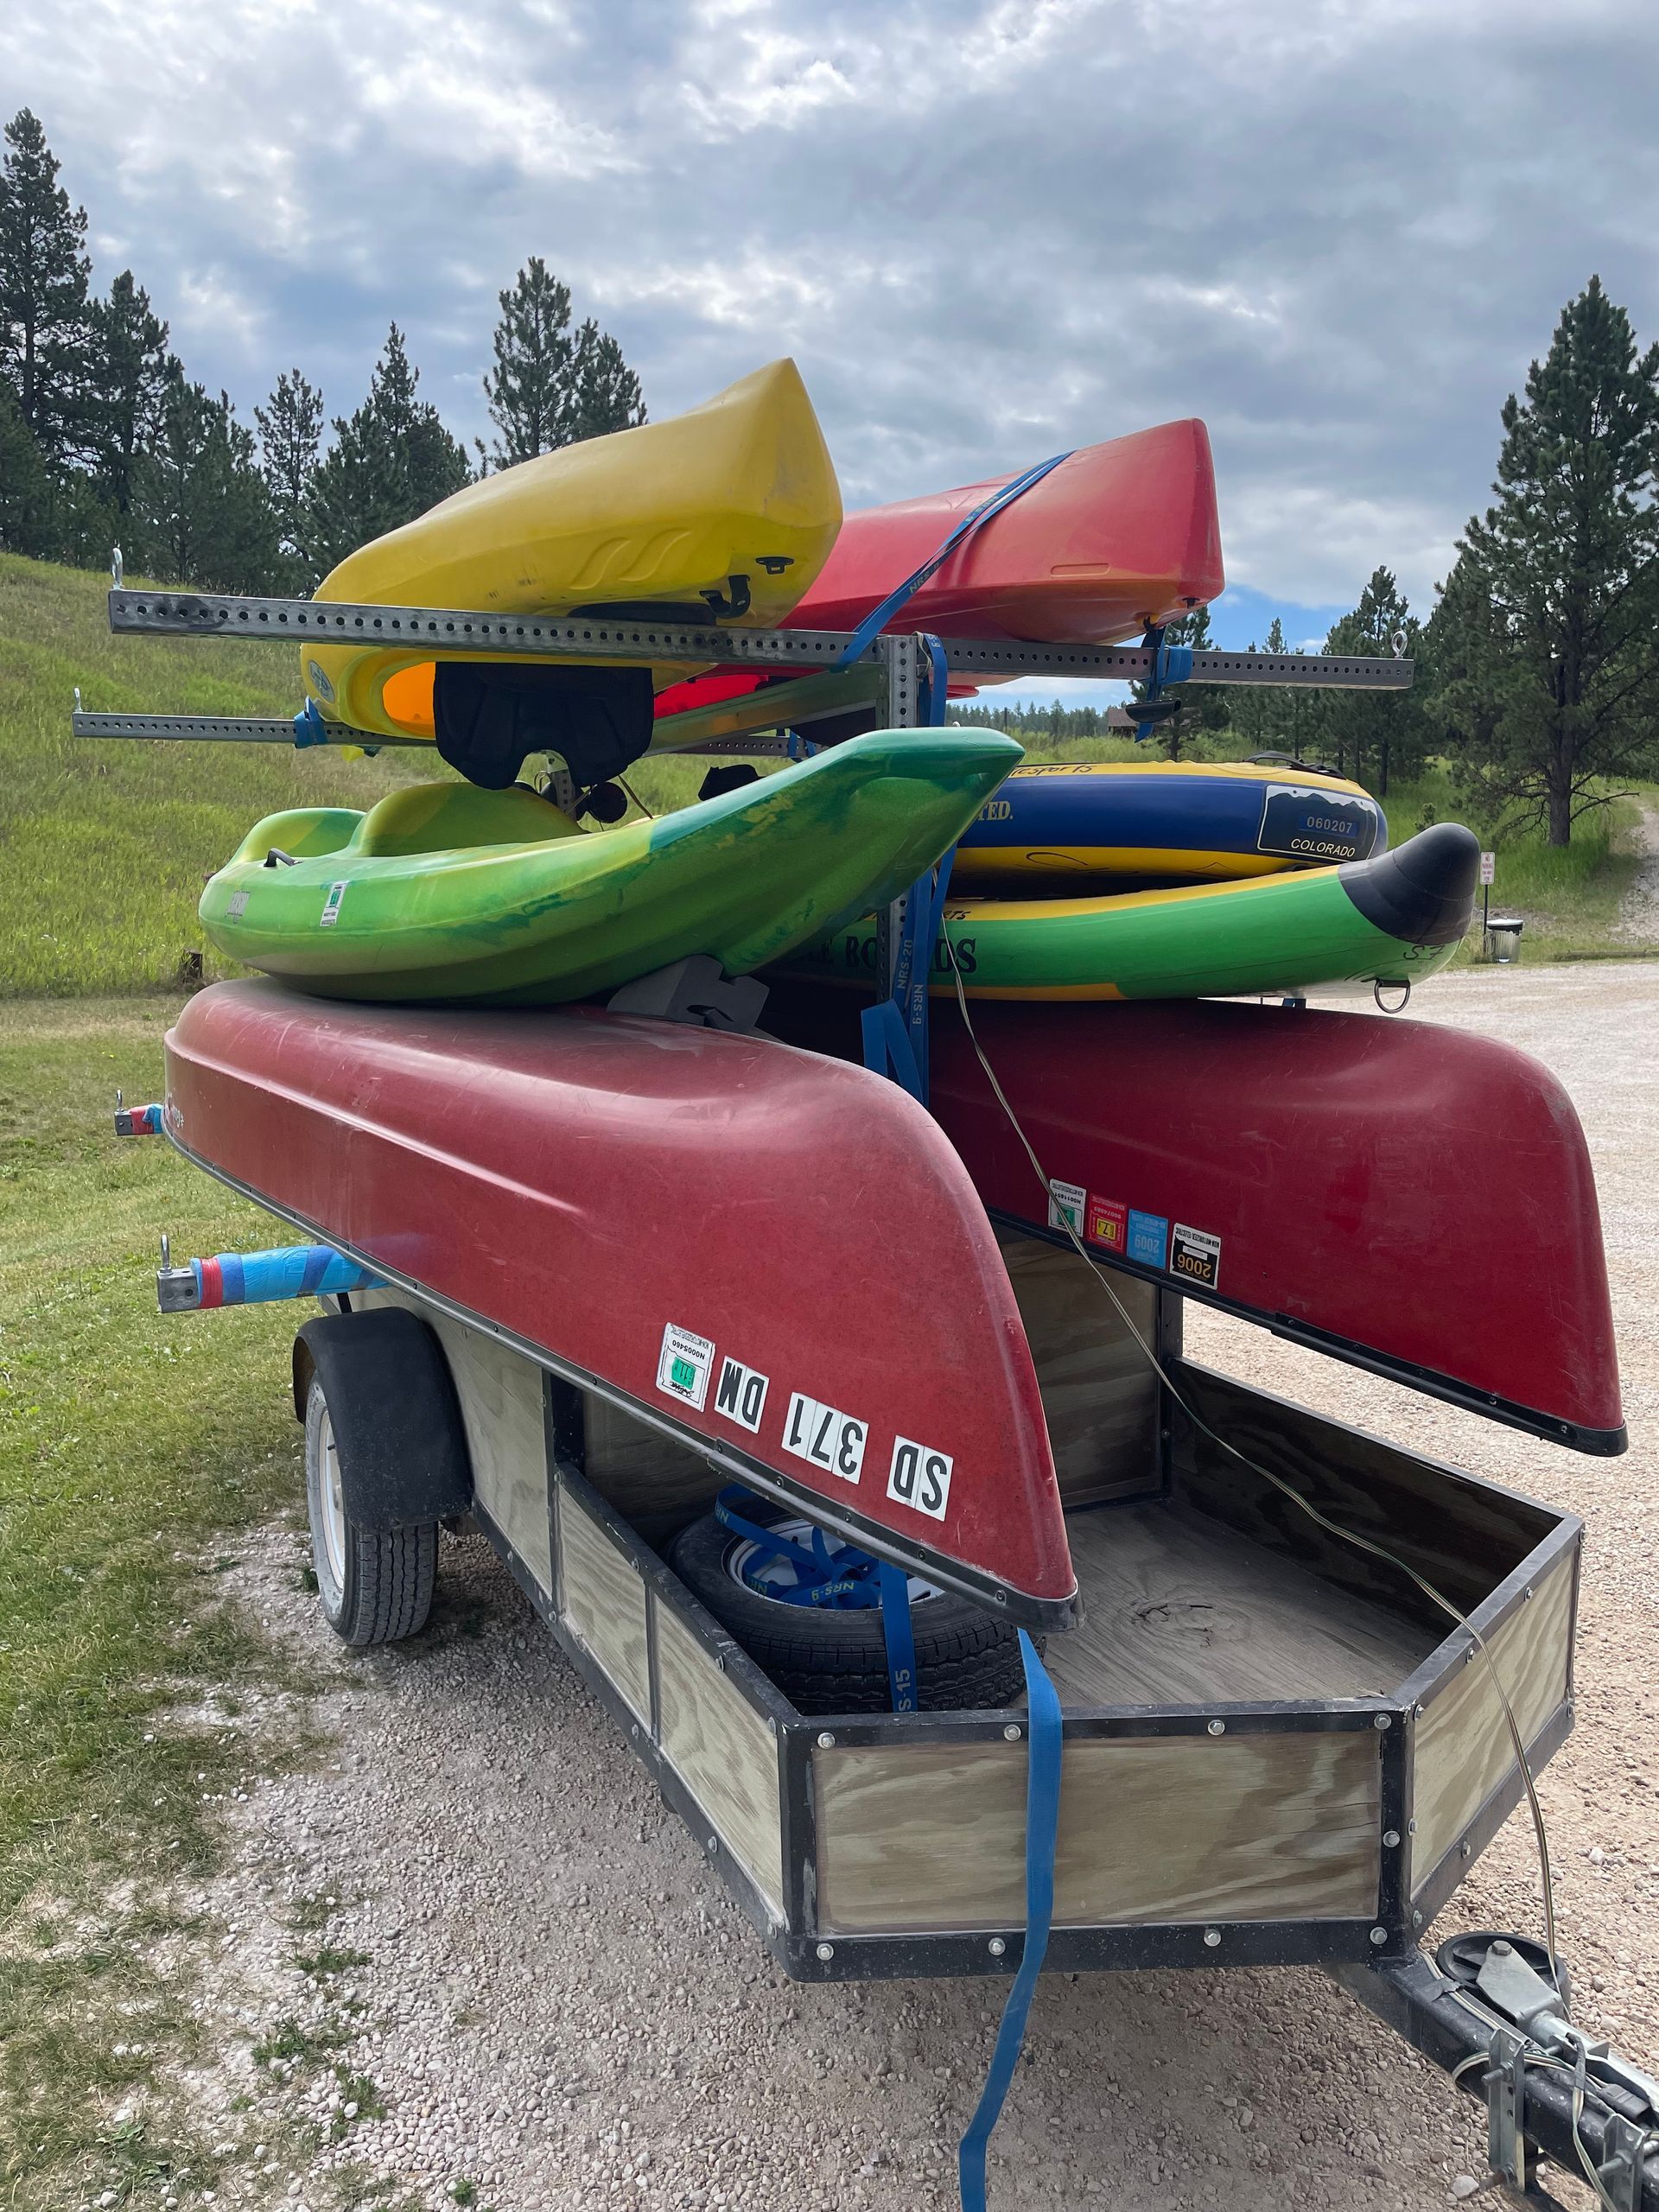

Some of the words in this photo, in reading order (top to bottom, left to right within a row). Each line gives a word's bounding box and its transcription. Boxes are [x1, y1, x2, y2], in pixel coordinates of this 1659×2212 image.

[1306, 816, 1353, 834] 060207
[1290, 838, 1356, 858] COLORADO
[845, 936, 977, 974] BODS
[912, 984, 924, 1025] NRS-9
[1103, 1223, 1109, 1236] 7
[1177, 1254, 1212, 1279] 2006
[717, 1362, 766, 1427] DM
[788, 1398, 865, 1476] 371
[893, 1443, 948, 1511] SD
[810, 1581, 855, 1601] NRS-9
